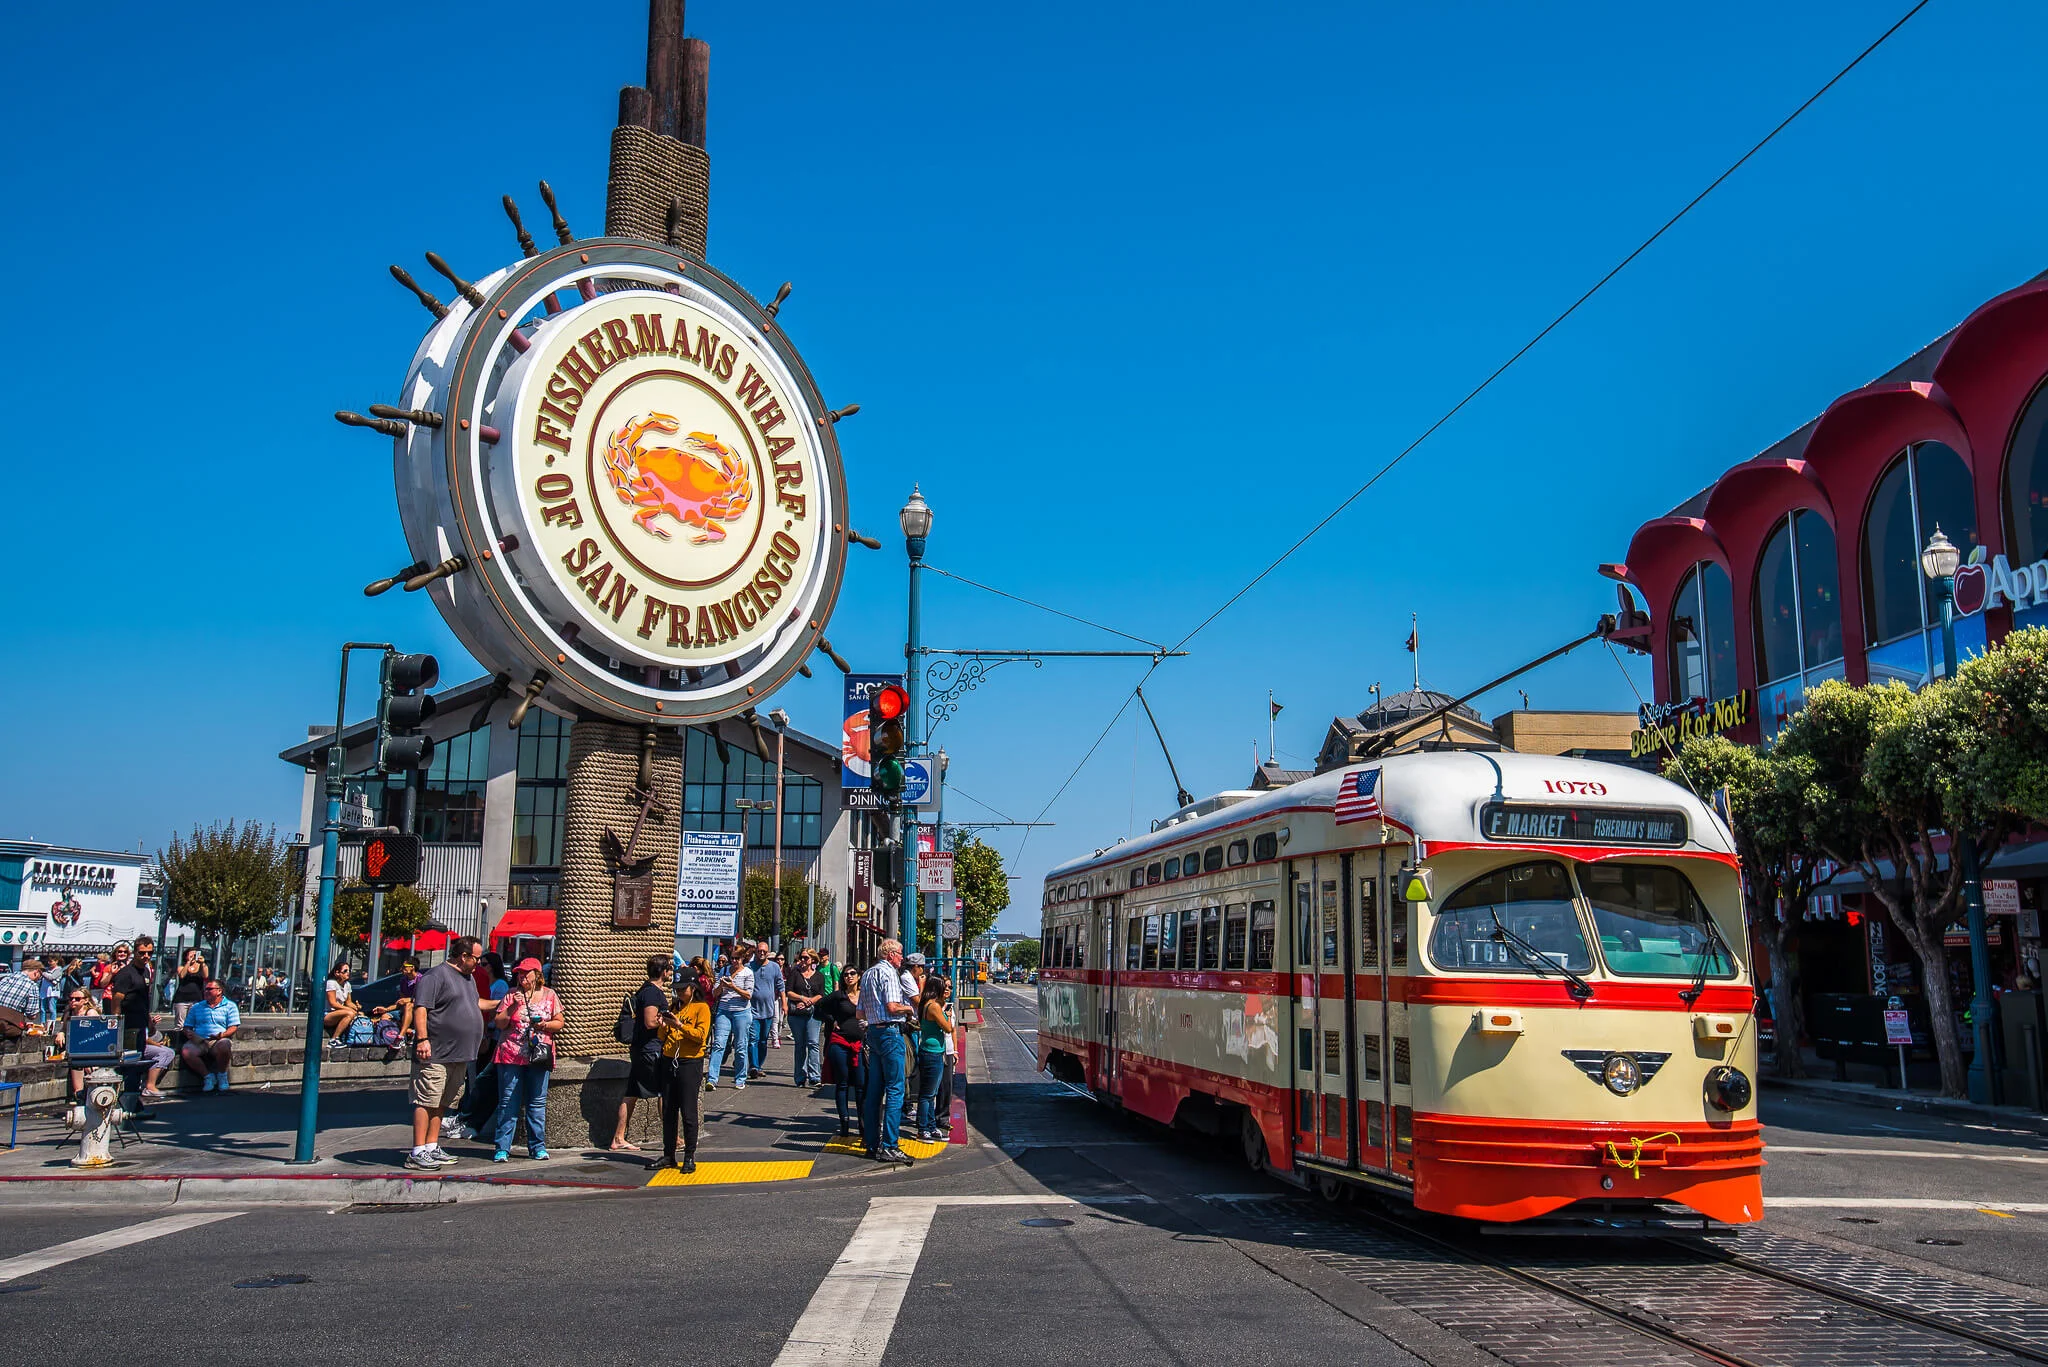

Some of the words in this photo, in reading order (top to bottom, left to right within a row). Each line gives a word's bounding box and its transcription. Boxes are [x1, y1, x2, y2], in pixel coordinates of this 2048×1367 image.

[533, 313, 739, 456] FISHERMANS
[735, 362, 807, 524] WHARF
[534, 471, 585, 530] OF
[561, 536, 639, 624] SAN
[636, 529, 802, 648] FRANCISCO
[1630, 724, 1676, 759] Believe
[1679, 711, 1692, 742] It
[1694, 712, 1711, 737] or
[1713, 689, 1746, 733] Not!
[1544, 780, 1608, 796] 1079
[341, 807, 376, 828] Jefferson
[1490, 812, 1503, 834] F
[1506, 813, 1566, 837] MARKET
[1593, 818, 1645, 839] FISHERMAN'S
[1646, 821, 1674, 840] WHARF
[687, 833, 720, 845] Fisherman's
[721, 835, 738, 846] Wharf
[695, 856, 727, 864] PARKING
[920, 859, 929, 868] NO
[929, 860, 952, 868] STOPPING
[34, 861, 115, 881] RANCISCAN
[928, 869, 944, 877] ANY
[928, 877, 944, 885] TIME
[1994, 881, 2016, 890] PARKING
[681, 888, 714, 900] $3.00
